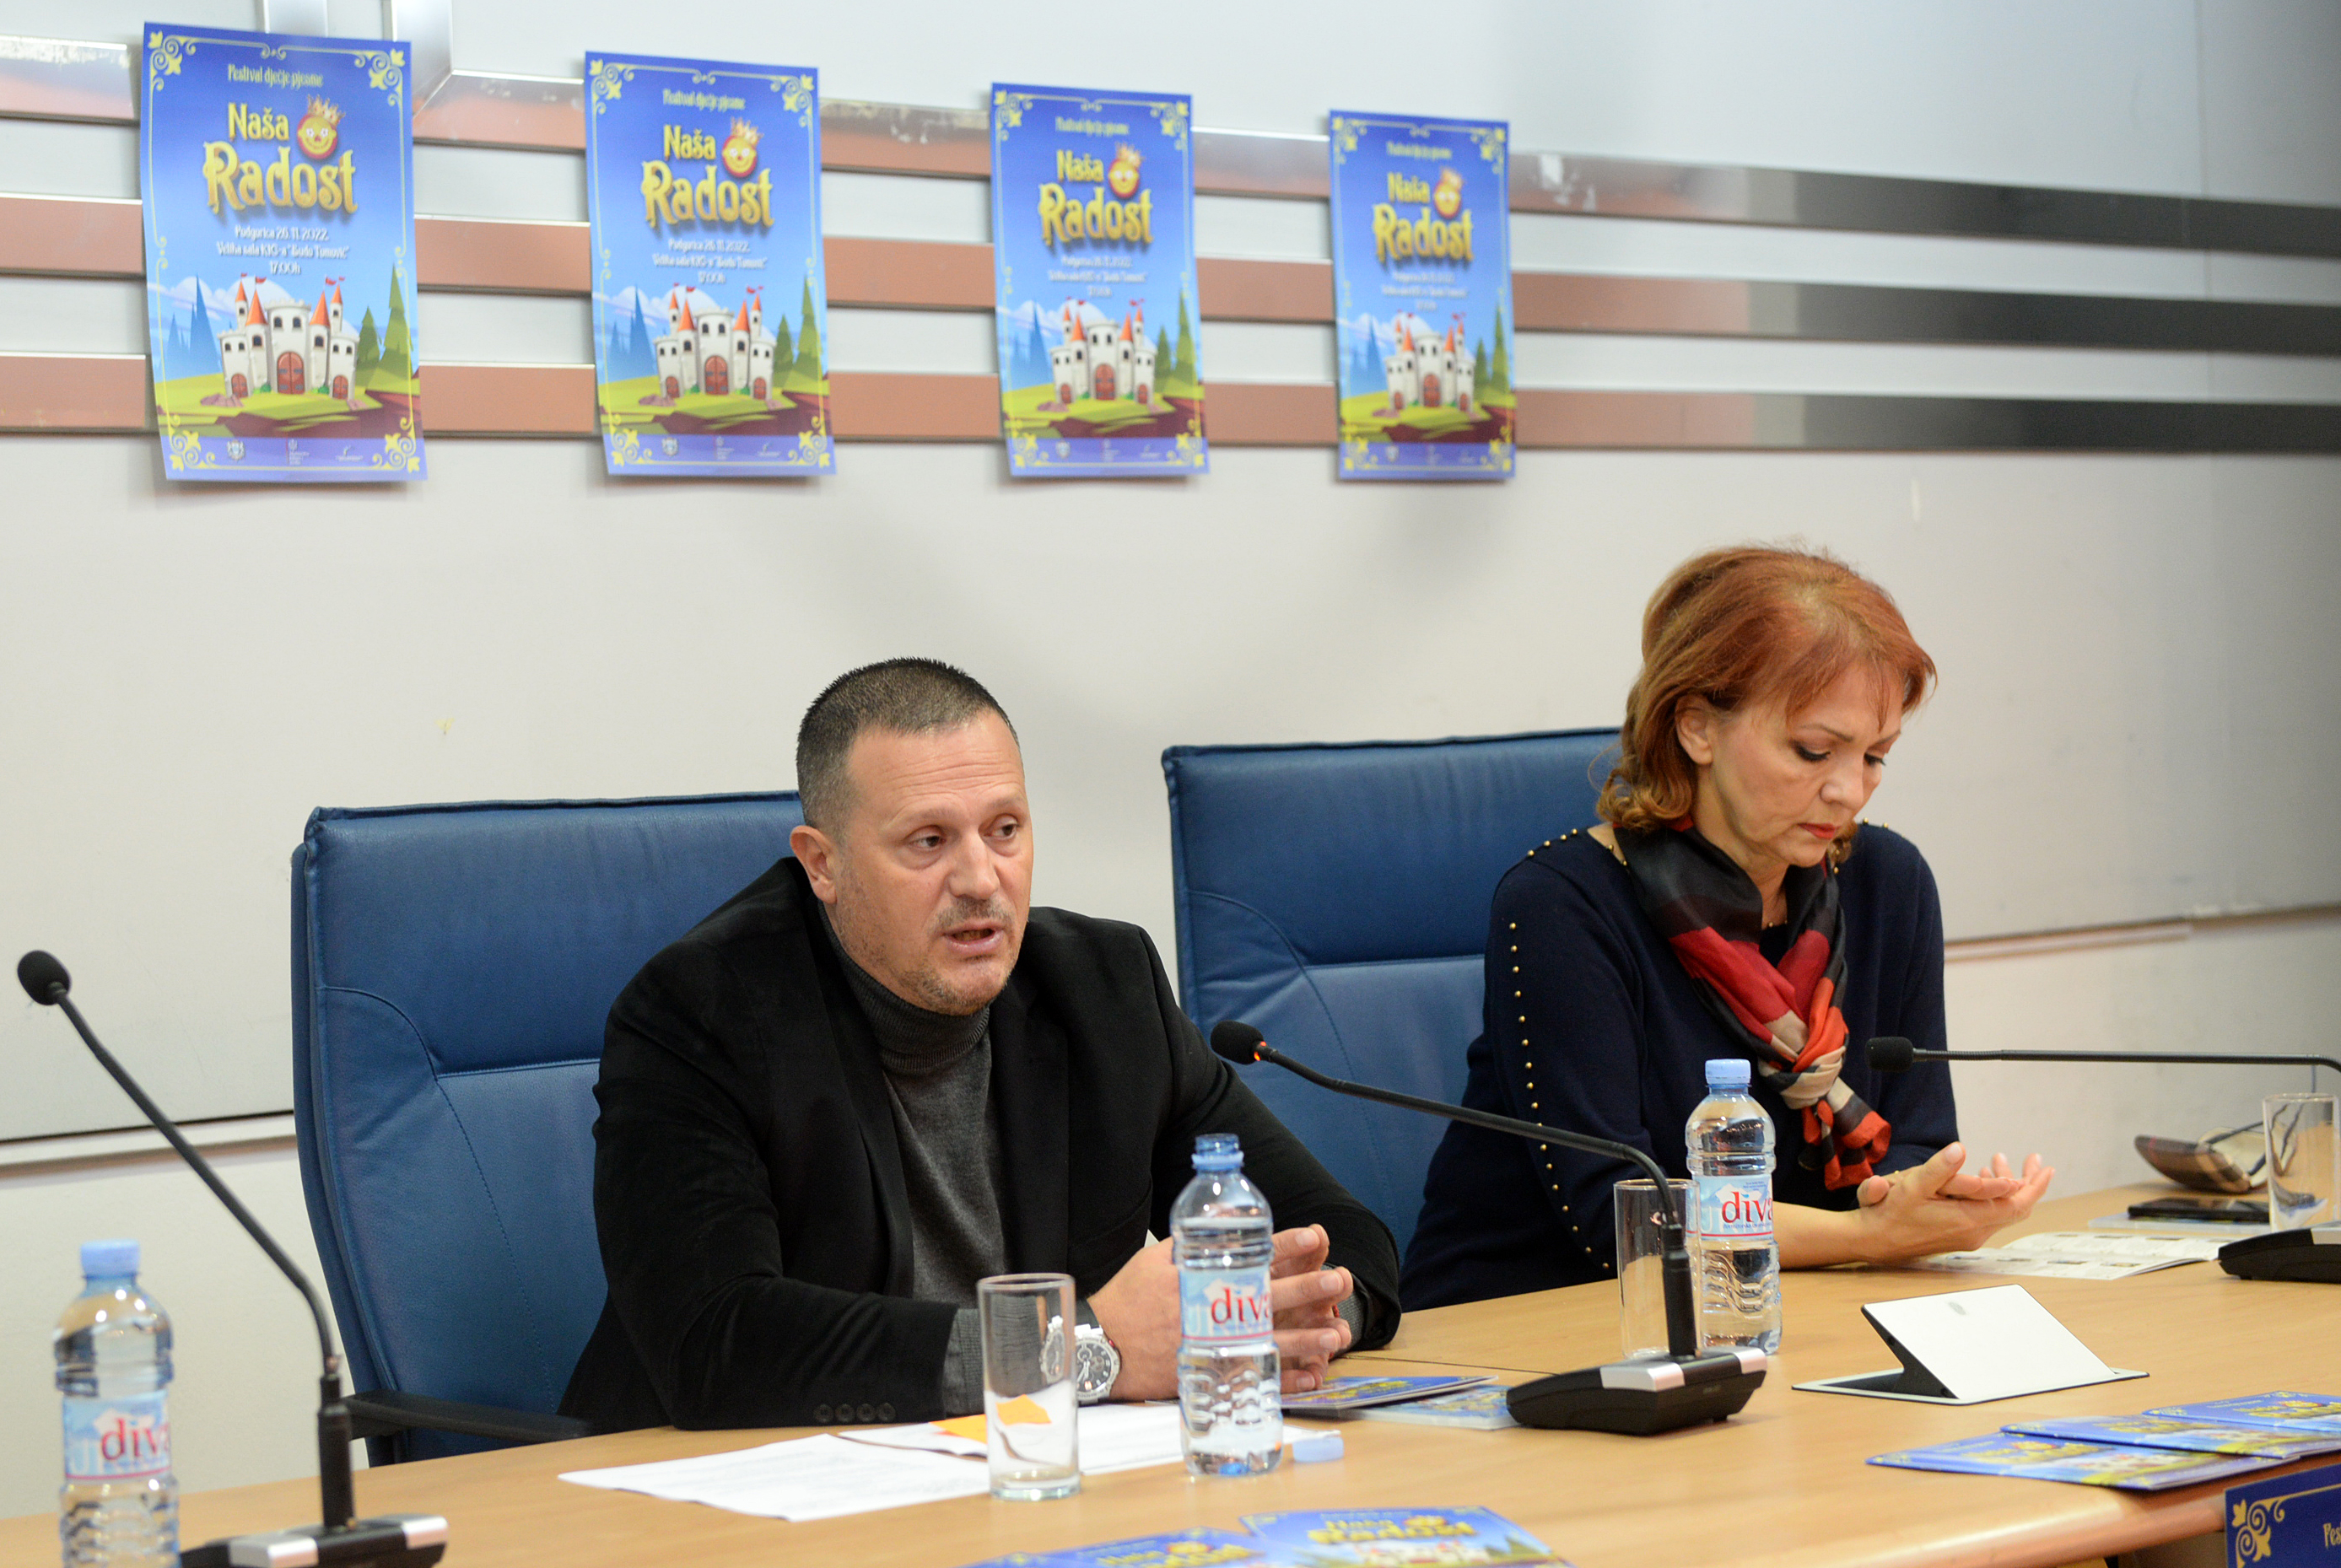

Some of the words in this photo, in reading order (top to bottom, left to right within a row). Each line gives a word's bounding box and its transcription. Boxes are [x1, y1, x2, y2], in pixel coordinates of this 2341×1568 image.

[229, 102, 289, 142] Naša
[663, 124, 715, 160] Naša
[203, 141, 358, 214] Radost
[641, 159, 774, 228] Radost
[1038, 183, 1154, 245] Radost
[1373, 203, 1474, 264] Radost
